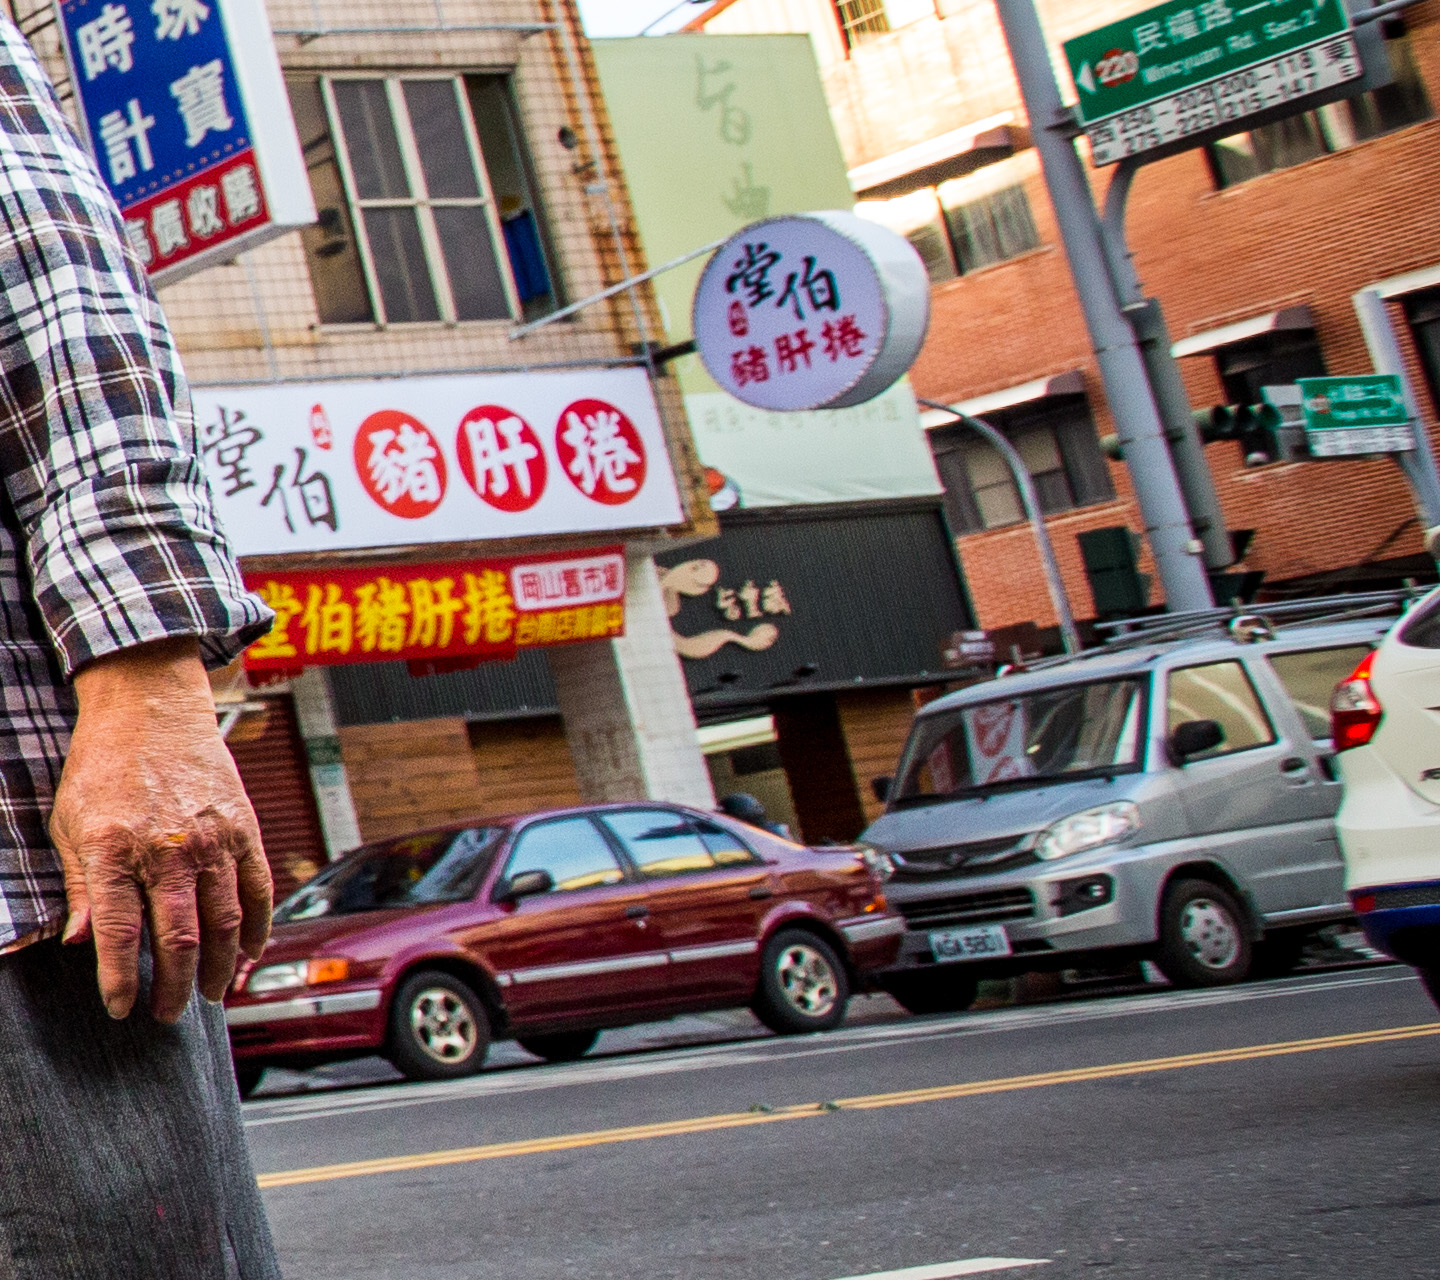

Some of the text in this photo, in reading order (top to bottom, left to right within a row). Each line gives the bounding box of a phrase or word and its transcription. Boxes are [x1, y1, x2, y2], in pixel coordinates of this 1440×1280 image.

[724, 242, 841, 321] 堂伯
[731, 312, 868, 388] 豬肝捲
[202, 404, 339, 533] 堂伯
[364, 396, 641, 506] 豬肝捲
